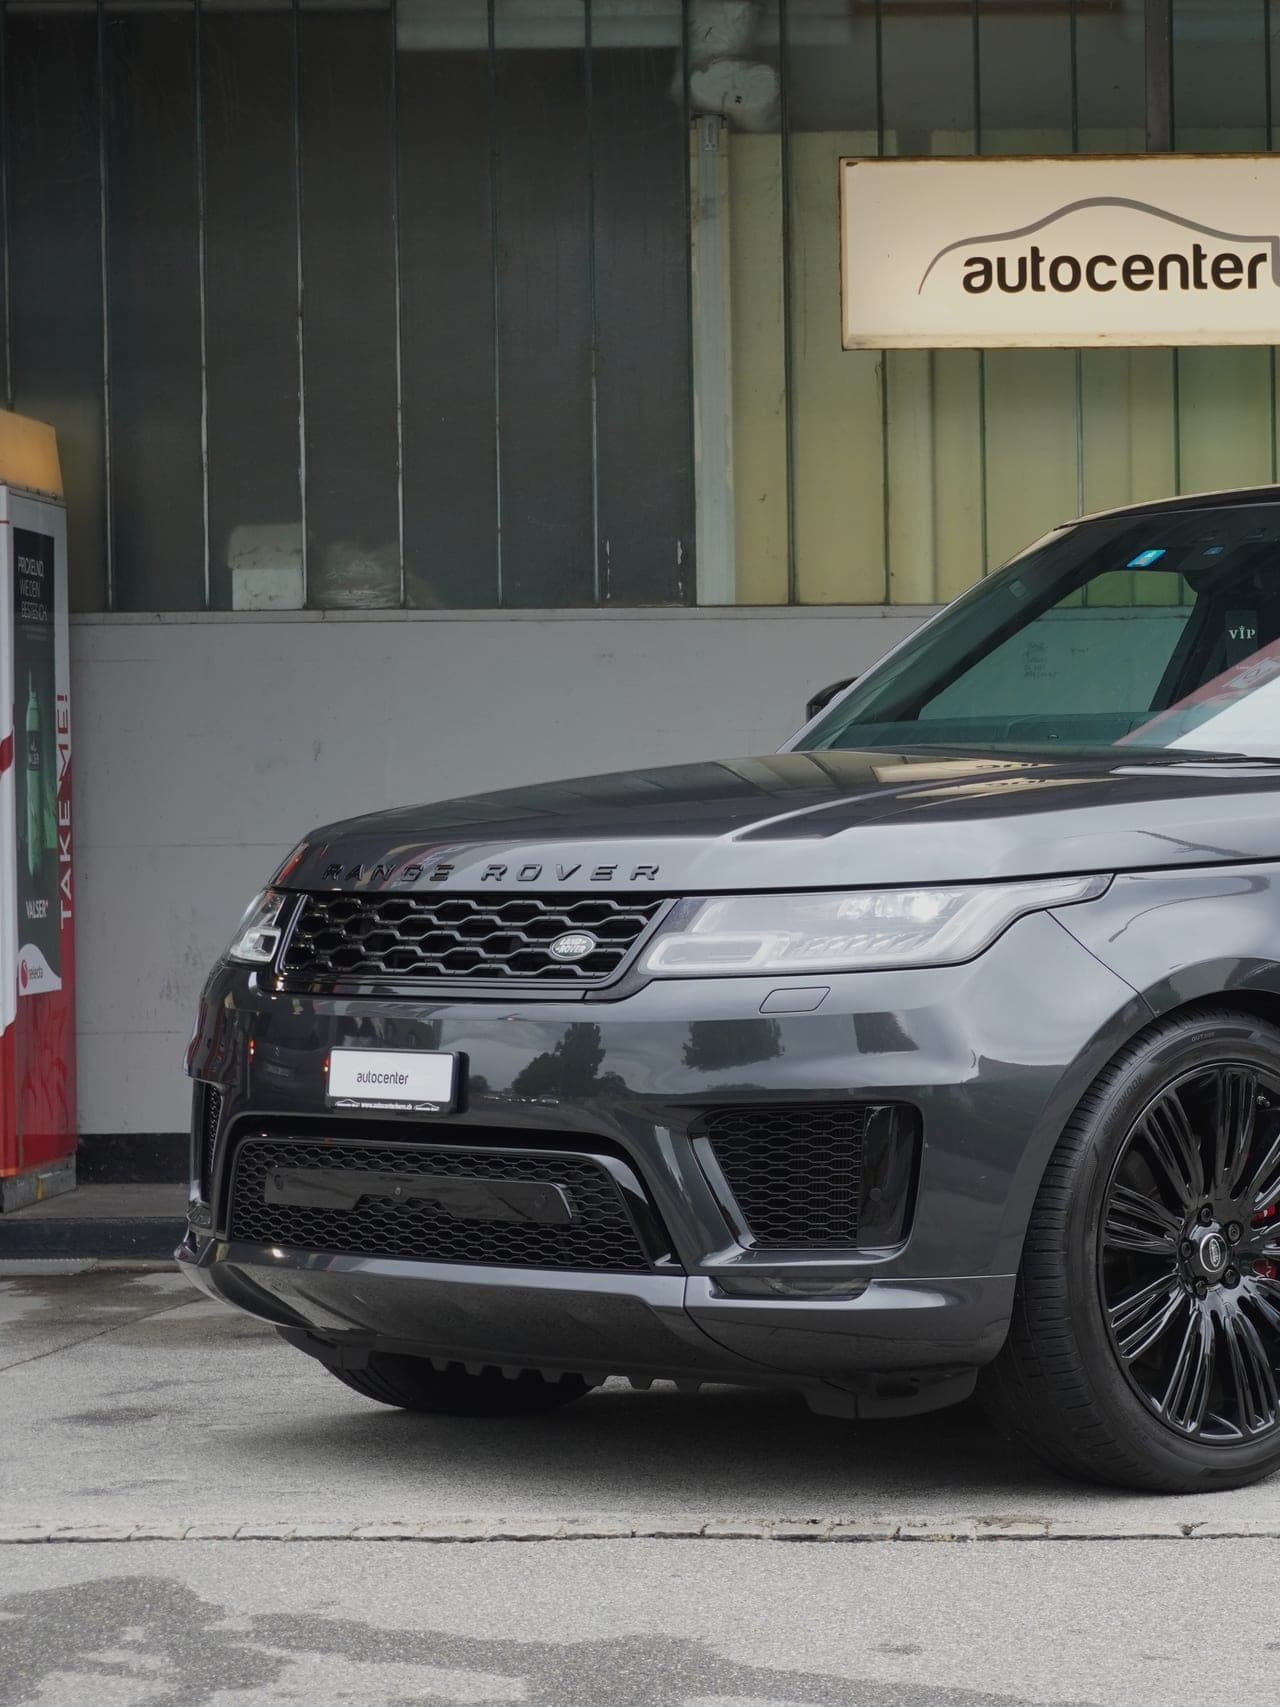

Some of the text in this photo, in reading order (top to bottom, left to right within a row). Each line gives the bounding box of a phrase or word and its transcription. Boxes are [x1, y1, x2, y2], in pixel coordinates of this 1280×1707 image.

[1228, 627, 1256, 640] VIP
[58, 800, 72, 930] TAKE
[320, 863, 660, 882] RANGE ROVER
[356, 1070, 409, 1085] autocenter
